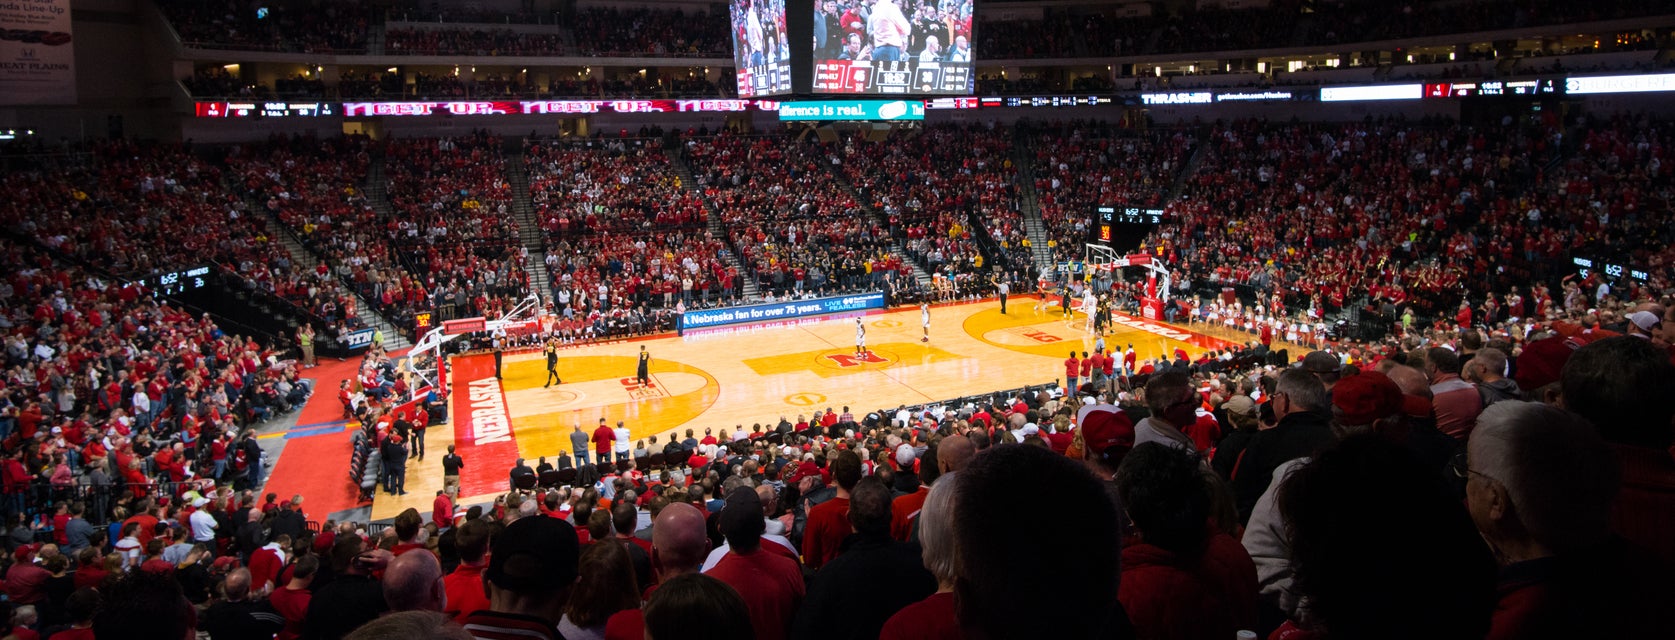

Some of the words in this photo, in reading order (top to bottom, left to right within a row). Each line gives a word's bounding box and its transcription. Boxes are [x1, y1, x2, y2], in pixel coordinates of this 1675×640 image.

[1141, 93, 1212, 104] THRASHER
[823, 104, 834, 116] is
[837, 103, 866, 116] real.
[829, 301, 866, 311] FEARLESS
[691, 311, 733, 324] Nebraska
[735, 310, 749, 319] fan
[751, 308, 763, 318] for
[765, 307, 784, 317] over
[785, 305, 796, 314] 75
[797, 304, 822, 315] years.
[826, 350, 888, 368] N
[468, 376, 512, 446] NEBRASKA
